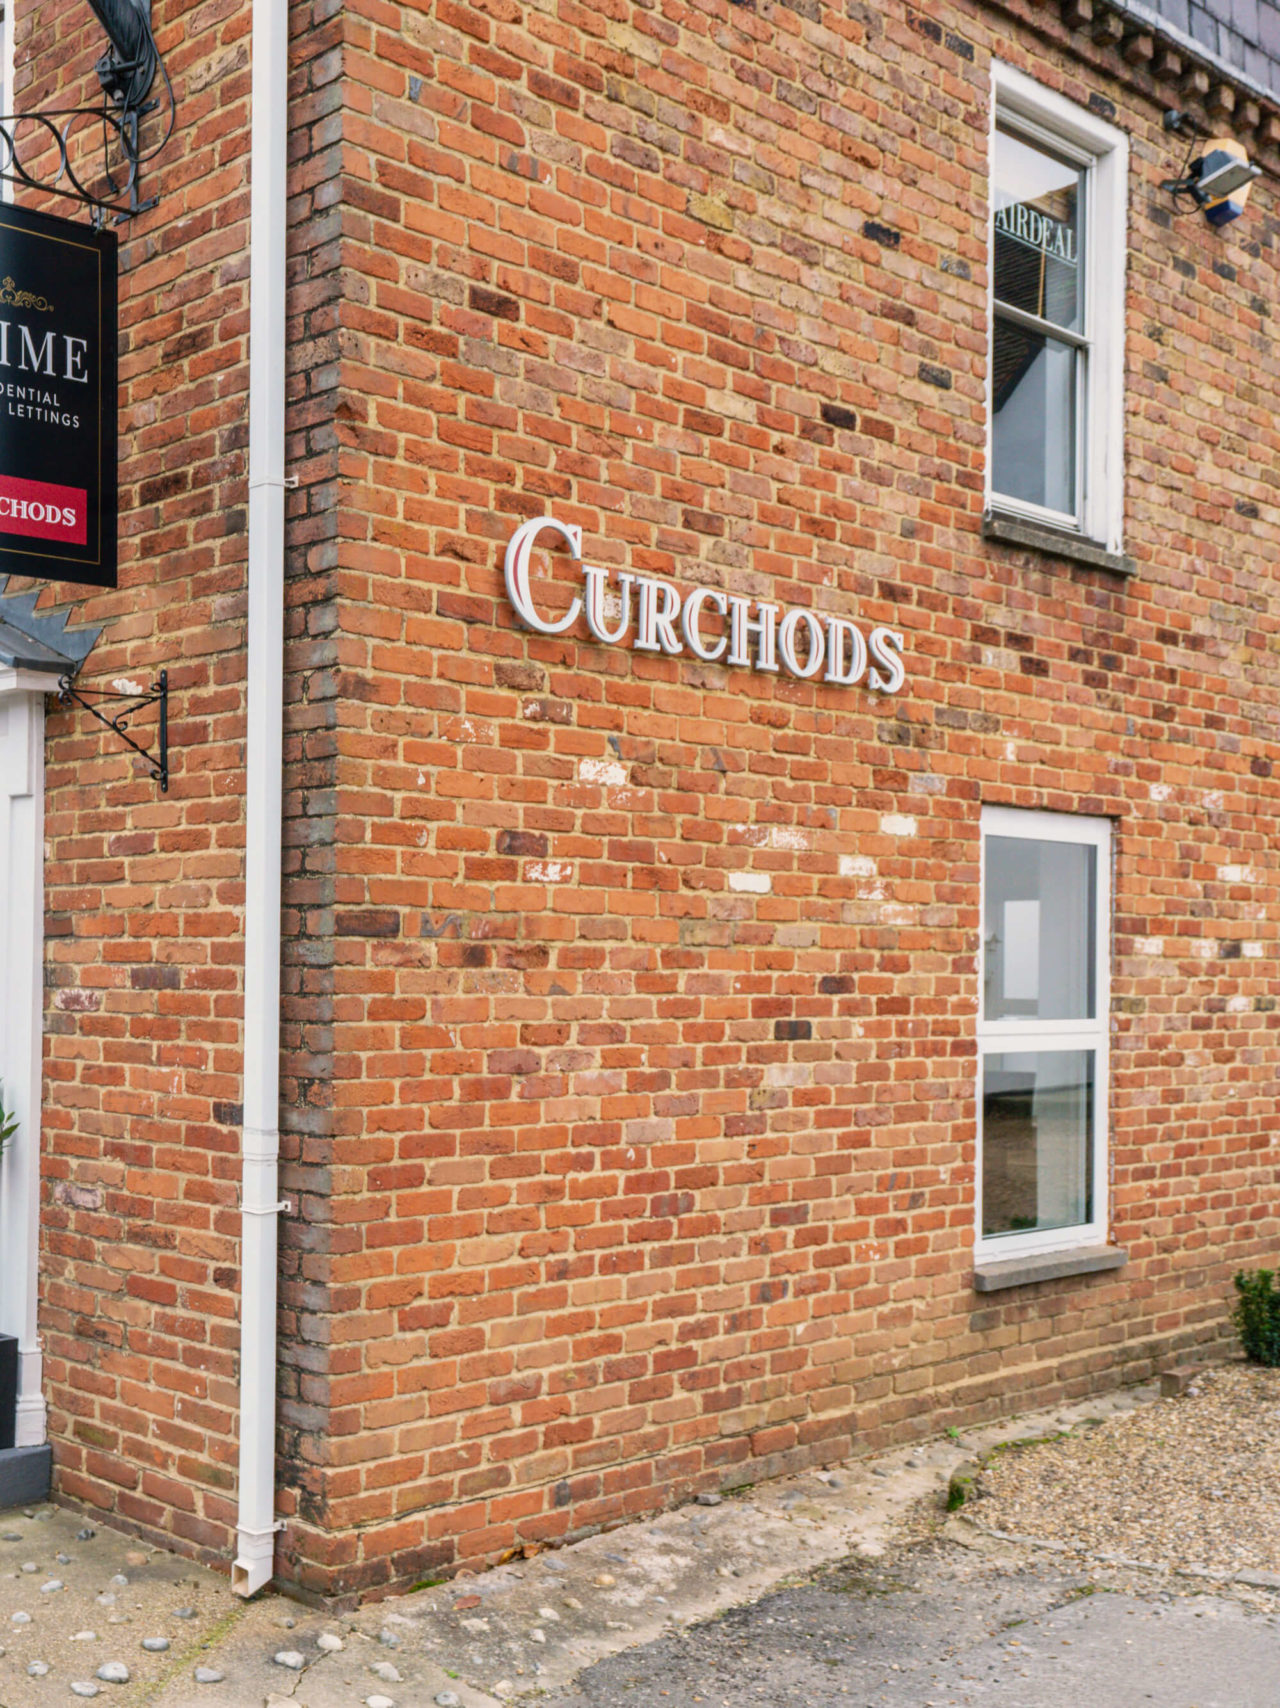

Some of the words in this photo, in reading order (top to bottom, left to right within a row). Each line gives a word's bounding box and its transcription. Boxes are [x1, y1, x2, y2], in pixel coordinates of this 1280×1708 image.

[995, 198, 1079, 263] AIRDEAL
[8, 401, 81, 429] LETTINGS
[504, 515, 906, 695] CURCHODS
